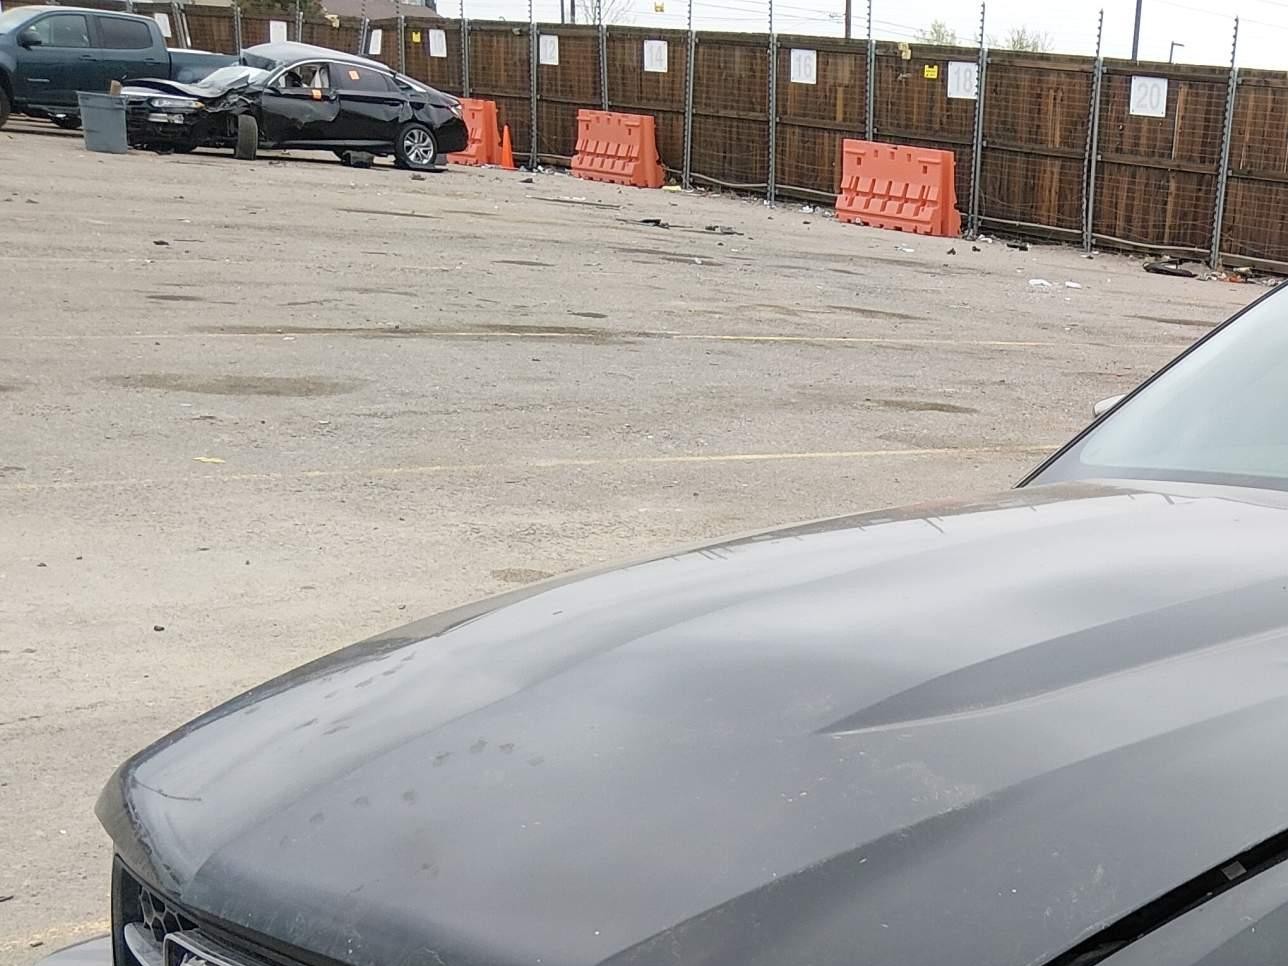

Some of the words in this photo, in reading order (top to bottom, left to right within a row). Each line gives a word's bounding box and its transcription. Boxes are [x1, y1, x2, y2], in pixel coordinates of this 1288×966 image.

[648, 44, 664, 67] 14
[796, 54, 812, 79] 16
[954, 66, 973, 93] 18
[1136, 82, 1161, 110] 20
